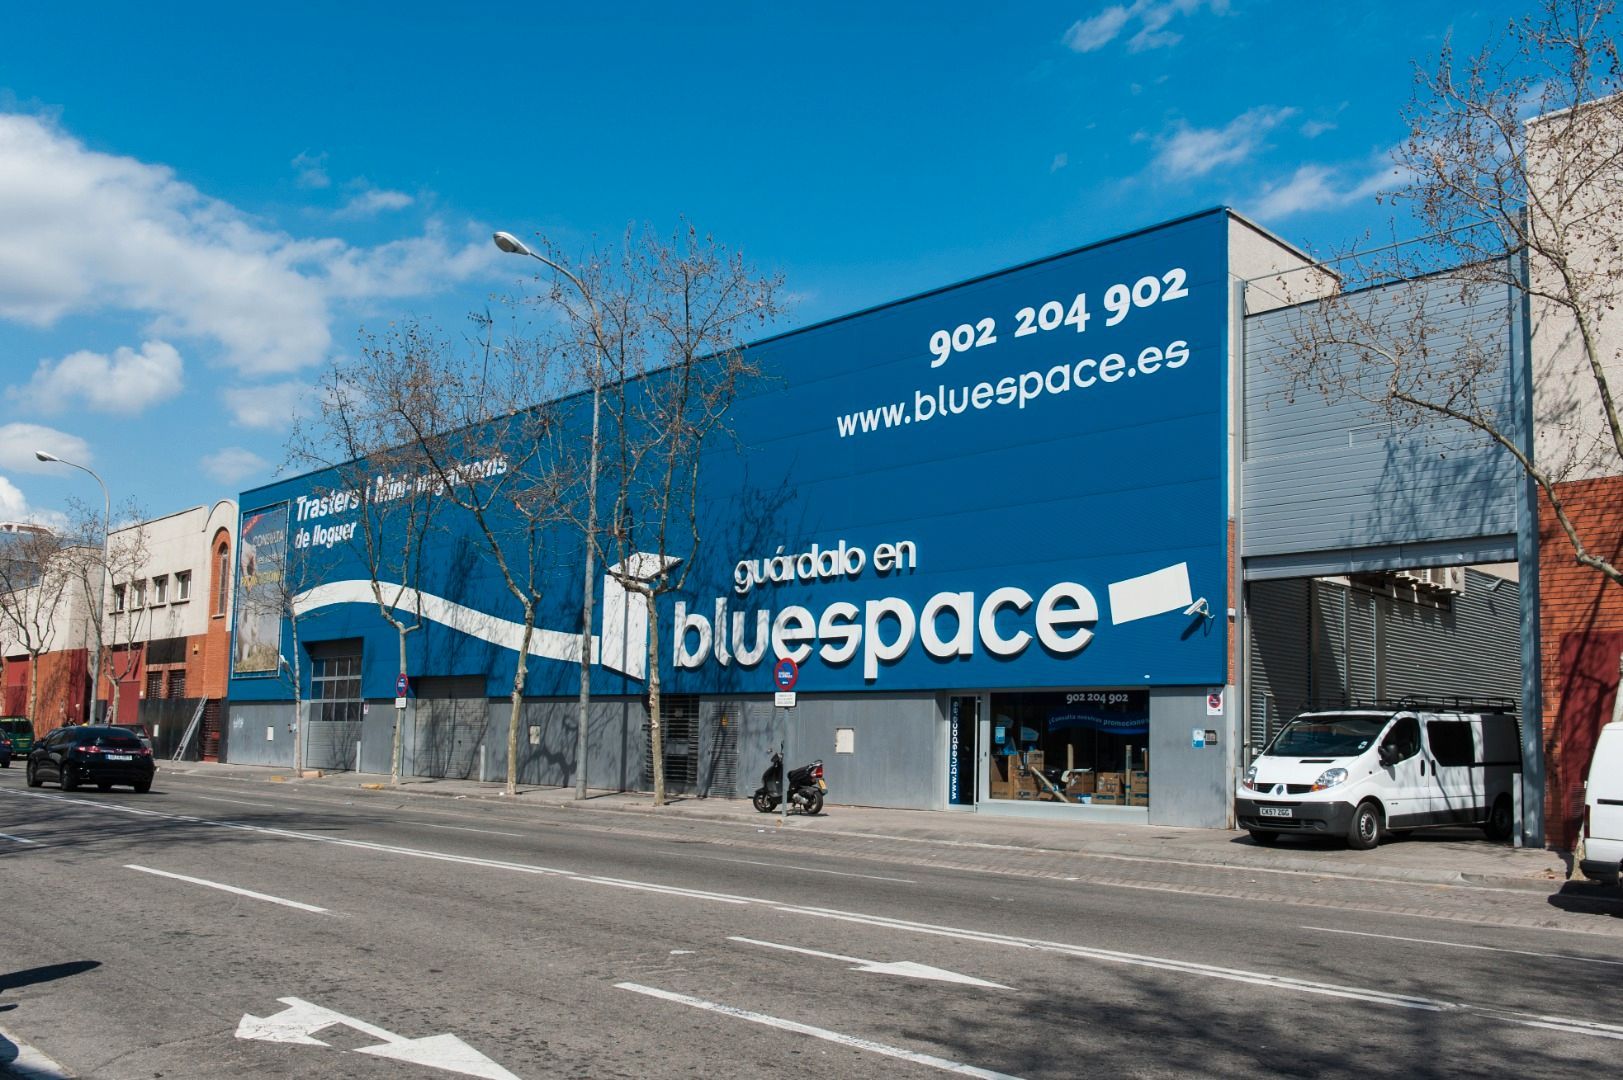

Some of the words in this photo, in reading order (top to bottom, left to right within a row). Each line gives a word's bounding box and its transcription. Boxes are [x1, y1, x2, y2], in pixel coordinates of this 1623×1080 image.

[929, 317, 997, 368] 902
[1014, 293, 1091, 333] 204
[1103, 268, 1189, 327] 902
[836, 340, 1190, 438] www.bluespace.es
[294, 527, 310, 549] de
[312, 520, 357, 549] lloguer
[296, 488, 361, 522] Trasters
[734, 539, 867, 594] guárdalo
[873, 540, 916, 571] en
[673, 581, 1099, 679] bluespace
[1066, 693, 1085, 704] 902
[1087, 693, 1106, 704] 204
[1108, 693, 1129, 704] 902
[950, 701, 959, 800] www.bluespace.es
